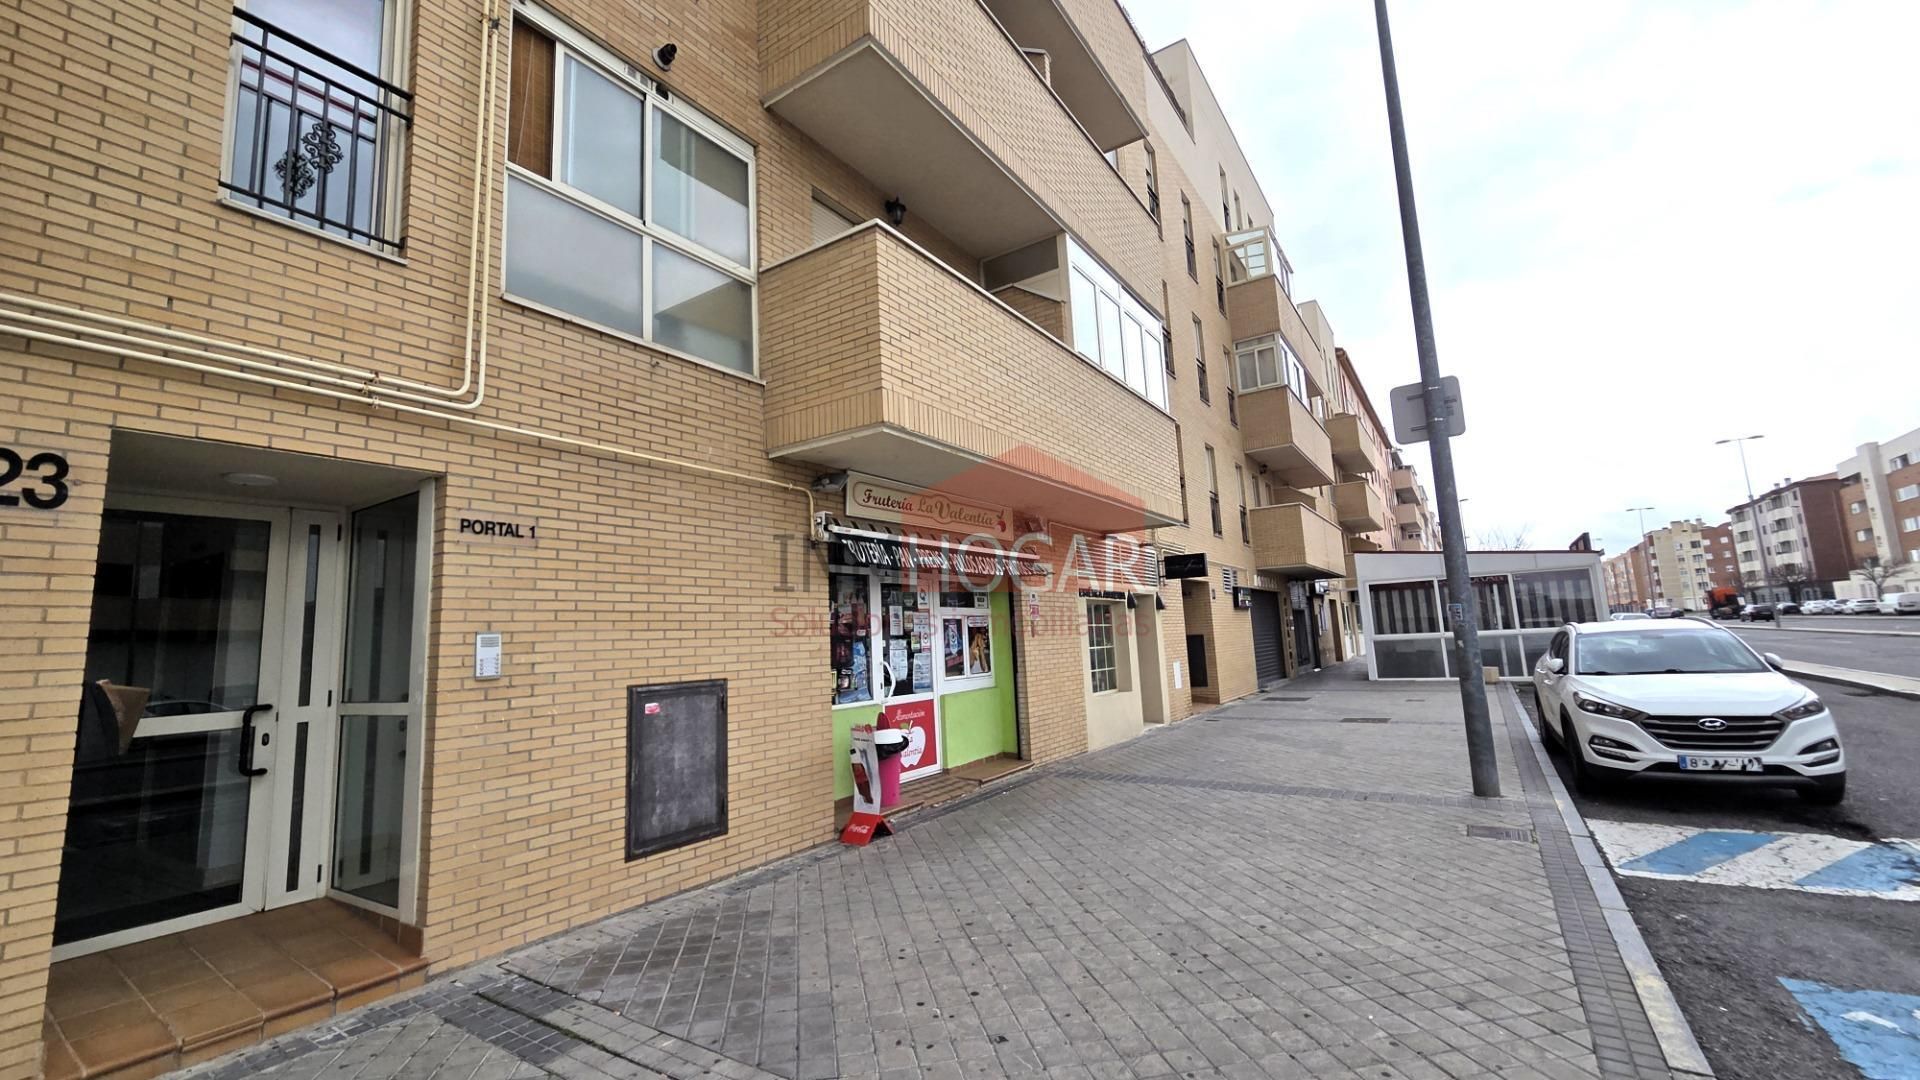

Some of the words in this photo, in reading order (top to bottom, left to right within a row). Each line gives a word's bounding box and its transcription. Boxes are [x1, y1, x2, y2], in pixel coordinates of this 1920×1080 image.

[0, 447, 69, 510] 23
[863, 488, 913, 512] Frutería
[917, 496, 933, 513] La
[460, 518, 524, 538] PORTAL
[529, 525, 536, 539] 1
[892, 546, 915, 568] PAN
